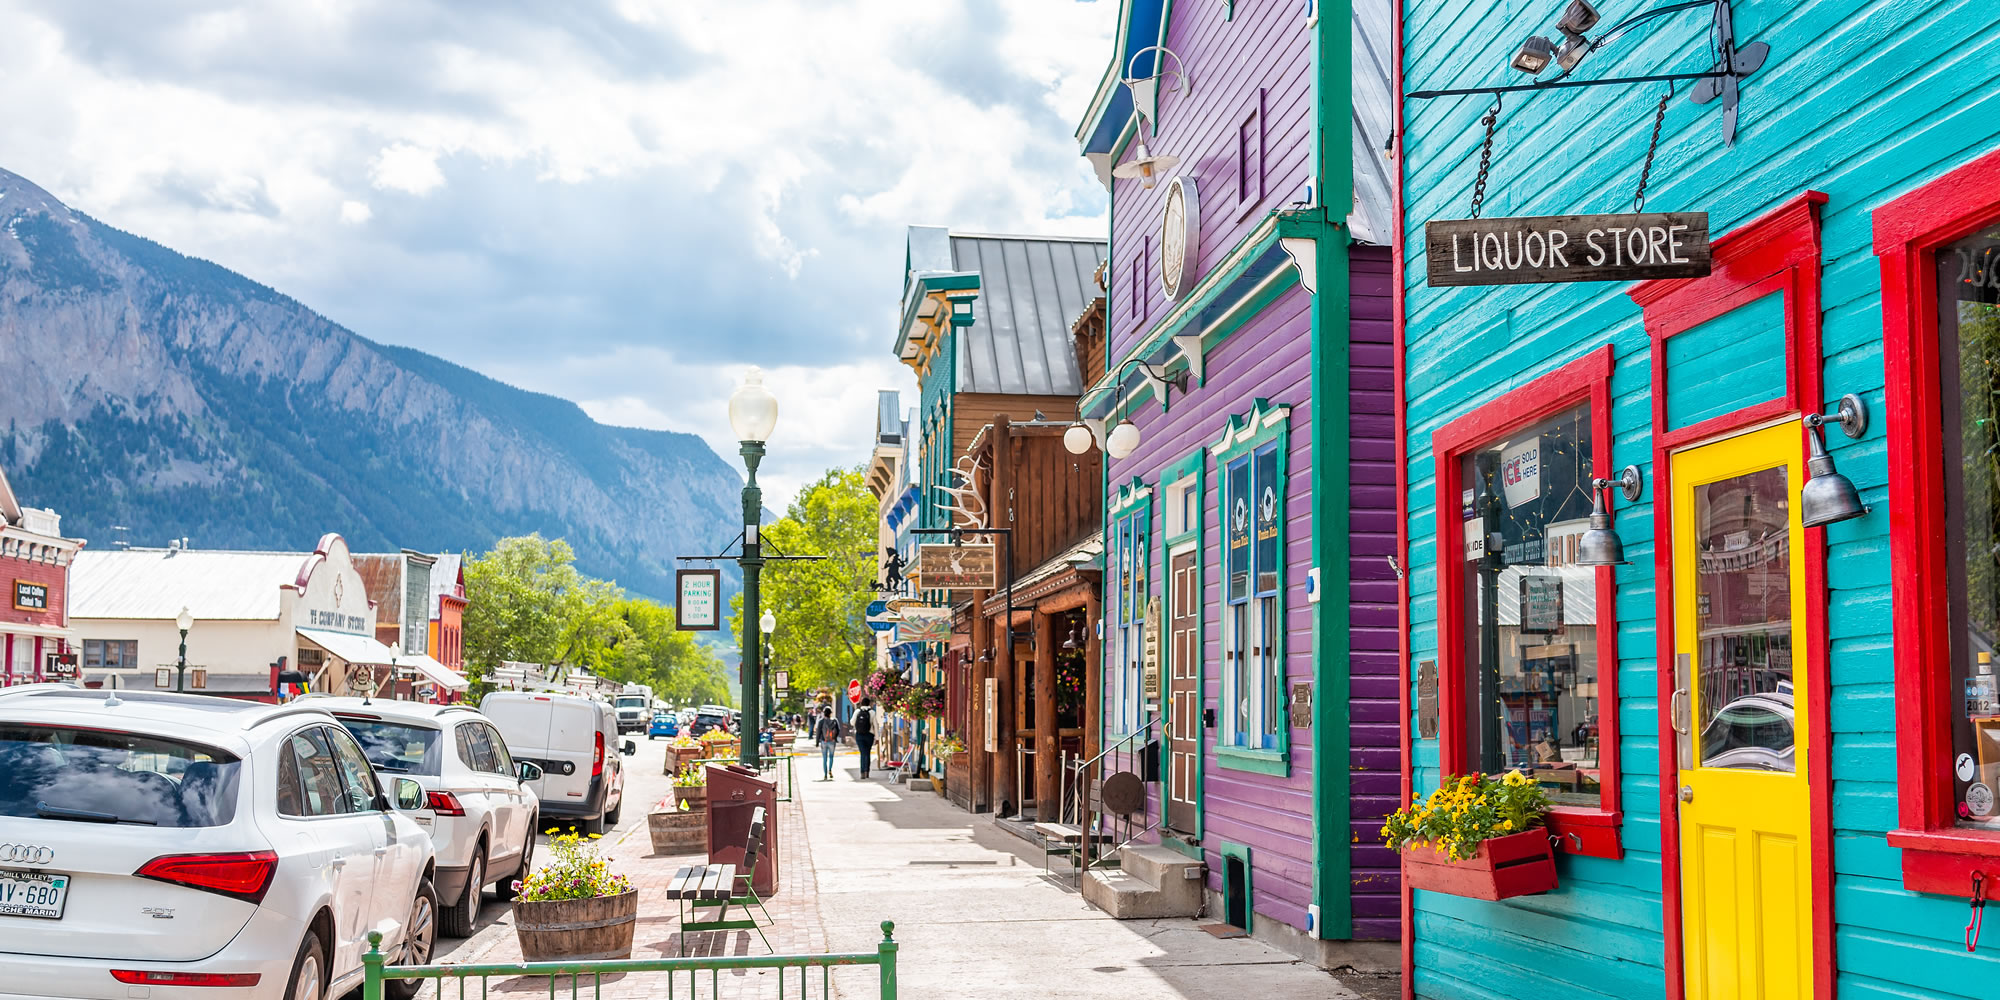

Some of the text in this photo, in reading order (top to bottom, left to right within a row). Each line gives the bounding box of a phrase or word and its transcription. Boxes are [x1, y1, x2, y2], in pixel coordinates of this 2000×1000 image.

[1453, 225, 1689, 272] LIQUOR STORE
[1522, 449, 1537, 464] SOLD
[1503, 455, 1521, 487] ICE
[1522, 464, 1537, 479] HERE
[19, 584, 31, 594] Local
[319, 611, 346, 628] COMPANY
[347, 615, 365, 631] STORE
[49, 655, 76, 672] T-bar
[849, 685, 861, 698] STOP
[1967, 701, 1989, 711] 2012
[21, 873, 48, 881] VALLEY
[25, 908, 57, 916] MARIN
